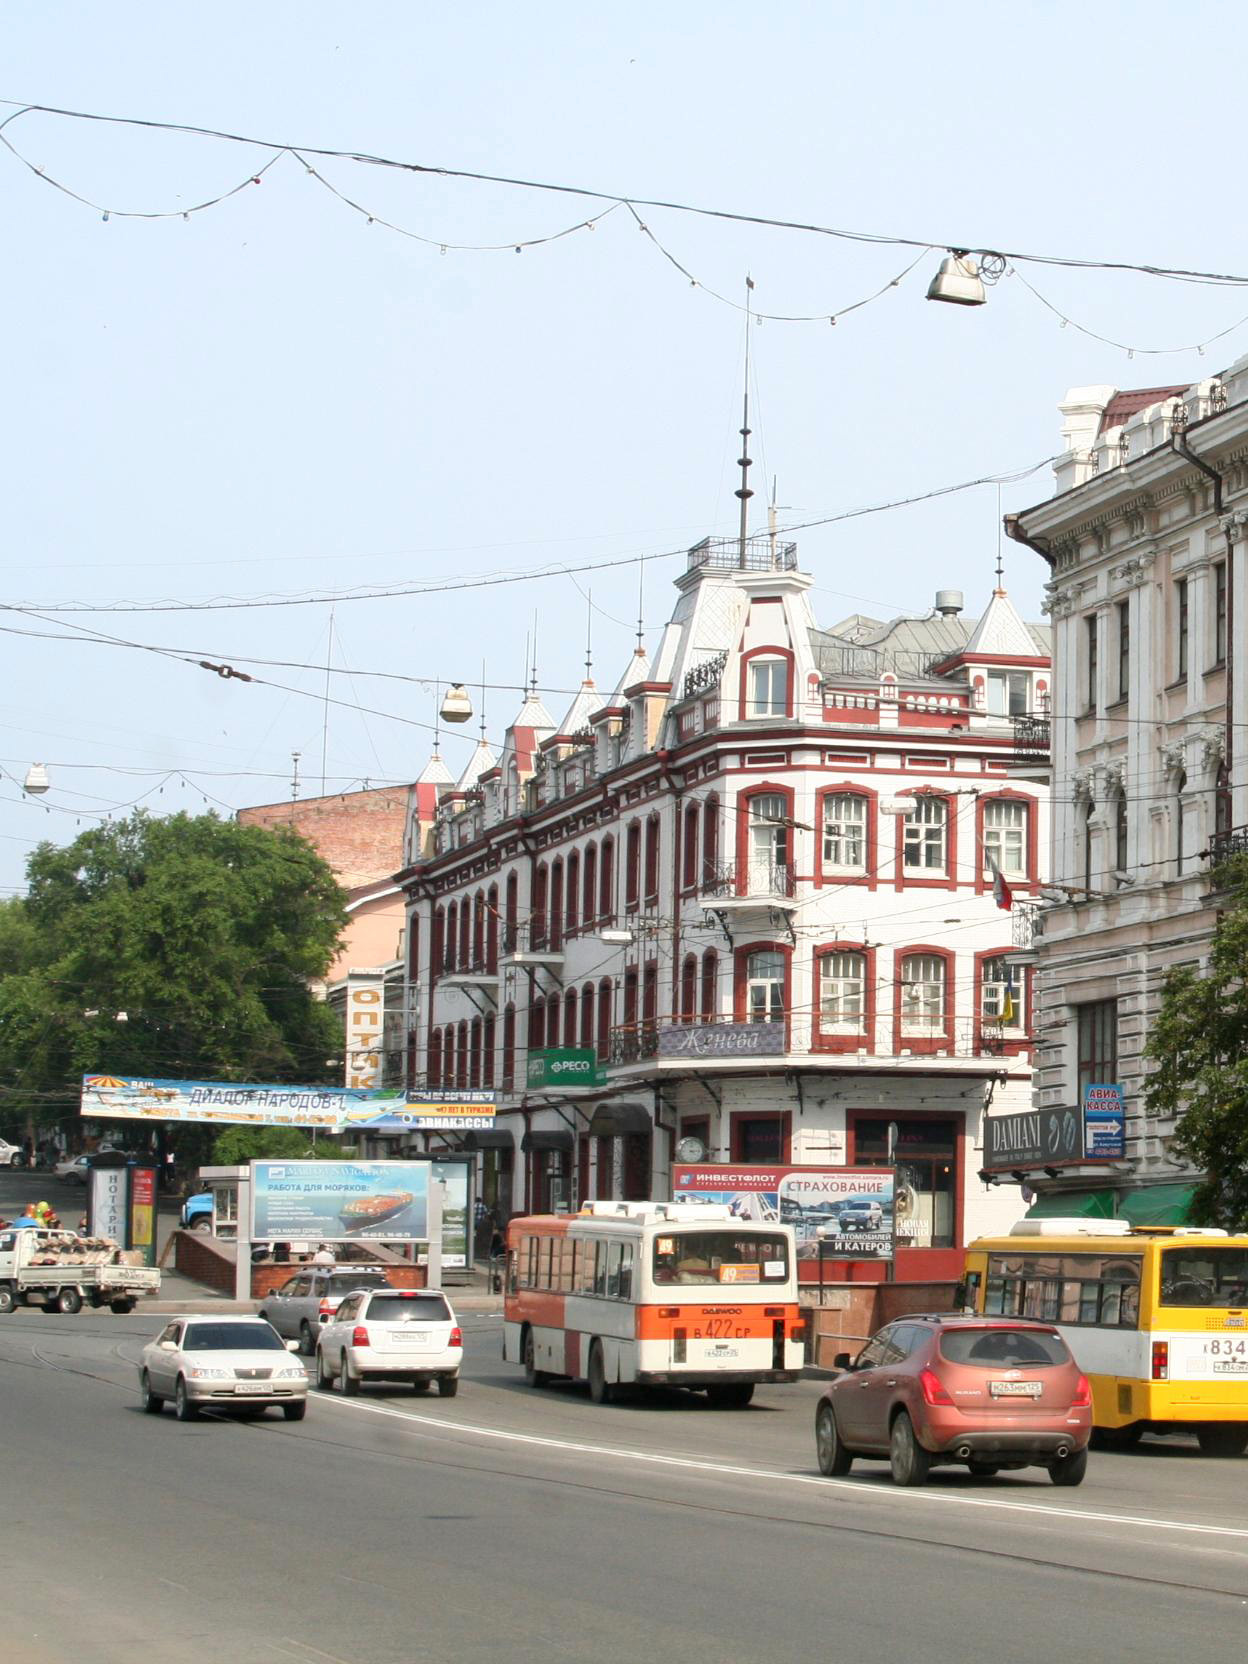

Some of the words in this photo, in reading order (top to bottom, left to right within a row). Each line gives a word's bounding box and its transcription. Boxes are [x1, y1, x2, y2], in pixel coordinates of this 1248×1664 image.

[679, 1029, 759, 1054] Женева
[562, 1061, 590, 1070] РЕСО
[1087, 1102, 1120, 1110] КАССА
[418, 1118, 493, 1128] АВИАКАССЫ
[993, 1115, 1041, 1151] DAMIANI
[697, 1174, 776, 1182] ИНВЕСТФЛОТ
[303, 1184, 321, 1192] ДЛЯ
[787, 1181, 883, 1193] СТРАХОВАНИЕ
[108, 1175, 118, 1239] НОТАРИ
[835, 1232, 891, 1241] АВТОМОБИЛЕЙ
[835, 1242, 842, 1250] И
[845, 1242, 891, 1251] КАТЕРОВ
[722, 1267, 737, 1281] 49
[706, 1319, 733, 1339] 422
[1211, 1340, 1246, 1355] 834
